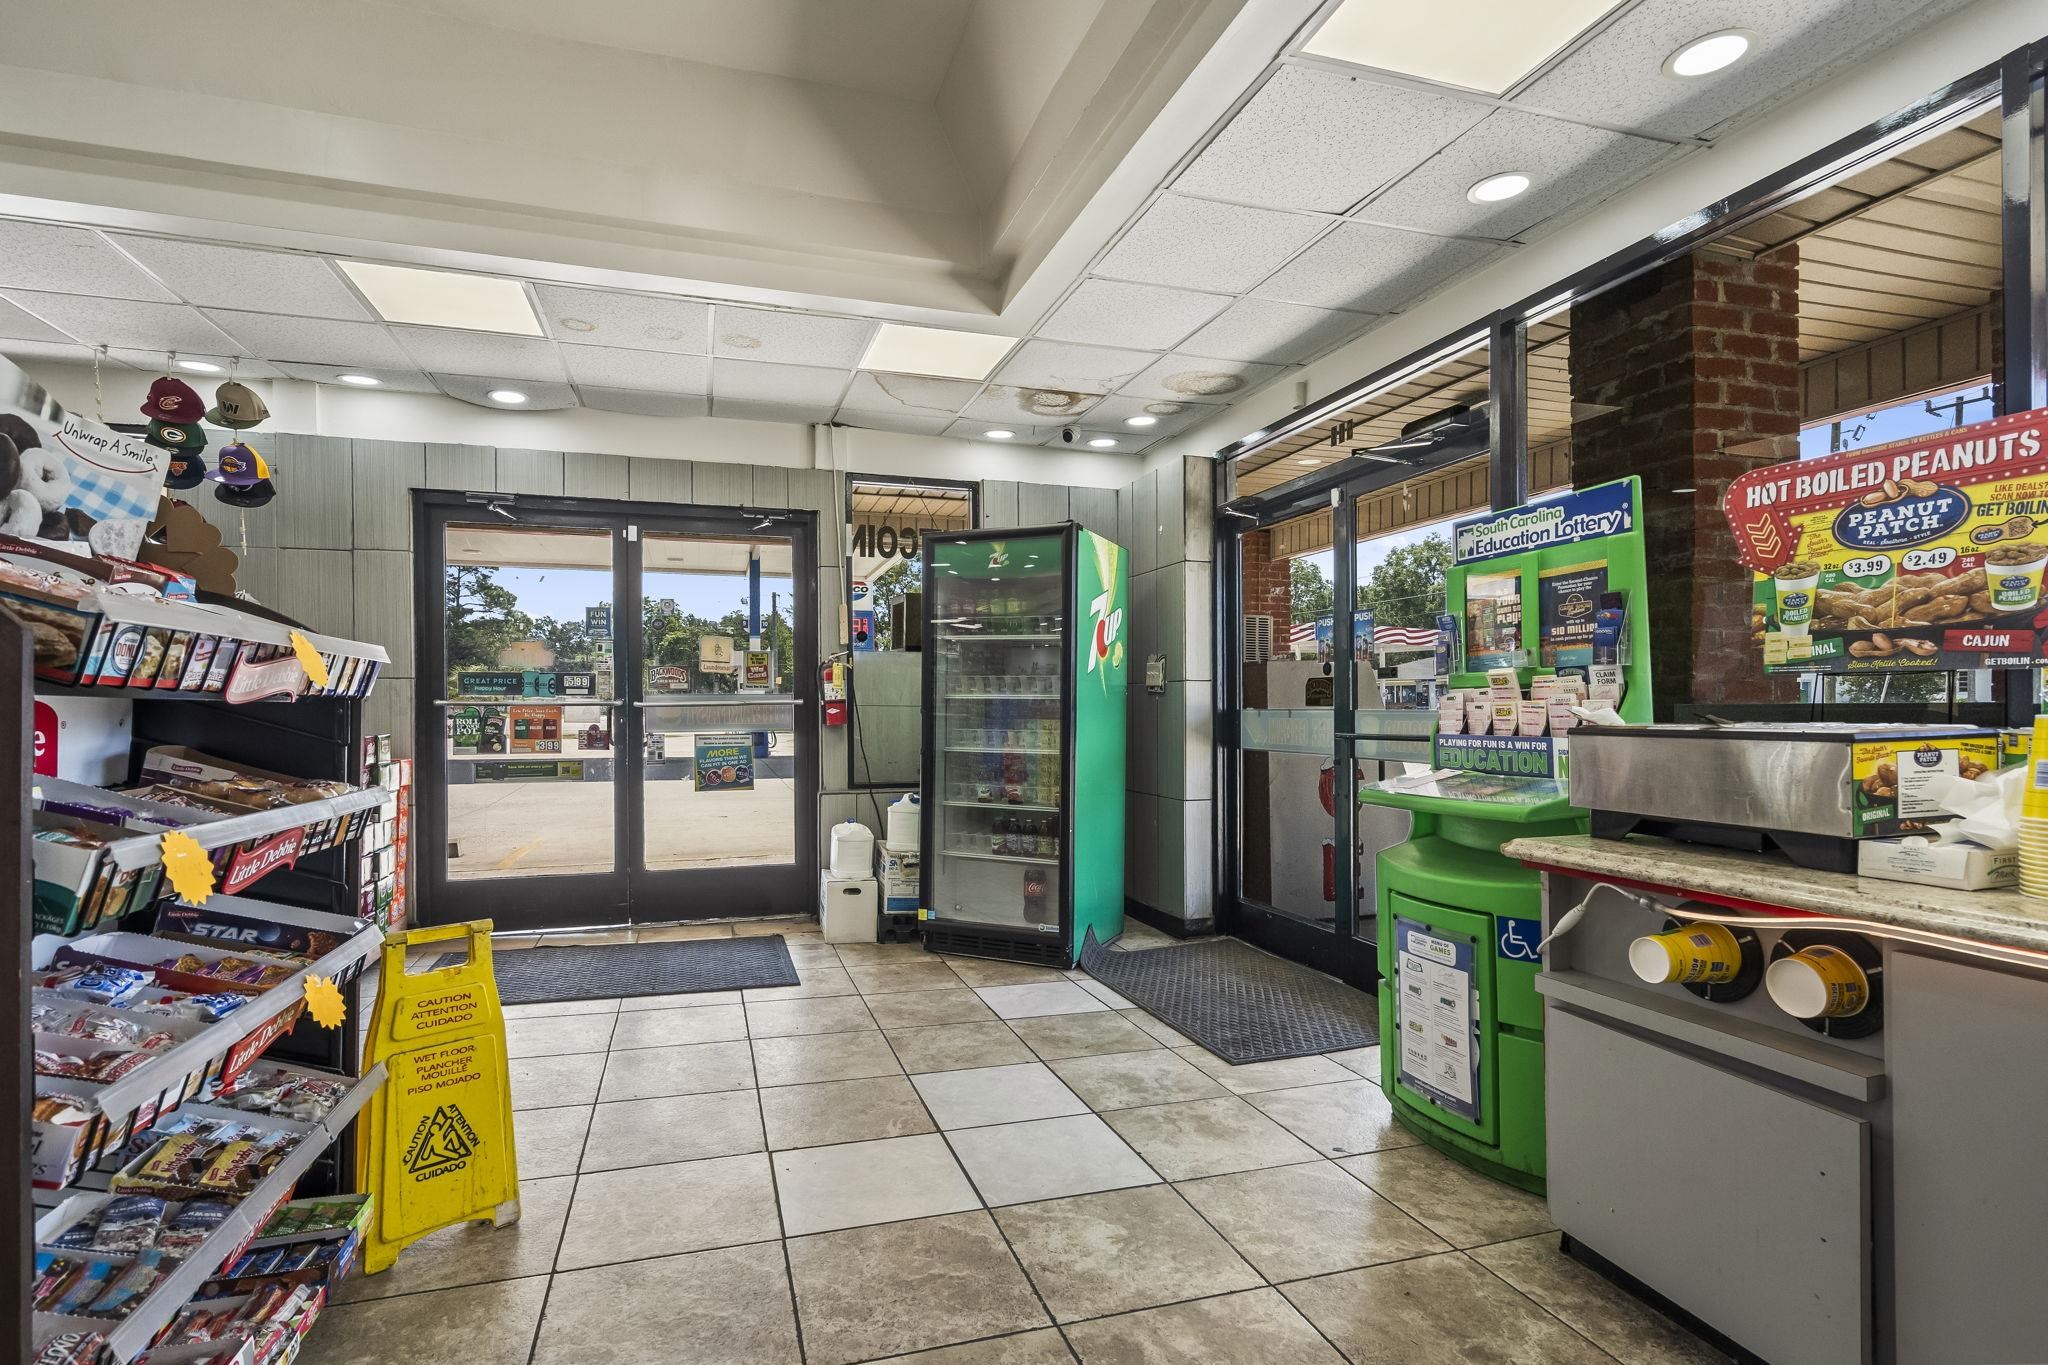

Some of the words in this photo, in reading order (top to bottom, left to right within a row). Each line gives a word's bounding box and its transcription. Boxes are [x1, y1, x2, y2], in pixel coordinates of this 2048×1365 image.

[63, 421, 108, 452] Unwrap
[109, 439, 120, 451] A
[122, 444, 153, 464] Smile
[1919, 432, 1943, 442] KETTLES
[1951, 427, 1968, 435] CANS
[1746, 479, 1791, 508] HOT
[1796, 462, 1885, 498] BOILED
[1893, 429, 2040, 481] PEANUTS
[1990, 492, 2014, 501] SCAN
[2016, 491, 2036, 500] NOW
[1995, 484, 2014, 492] LIKE
[1849, 498, 1952, 527] PEANUT
[1977, 502, 2003, 517] GET
[1475, 522, 1508, 537] South
[1510, 508, 1562, 528] Carolina
[1858, 515, 1940, 539] PATCH
[1476, 529, 1550, 555] Education
[1555, 511, 1620, 538] Lottery
[1914, 531, 1931, 540] STYLE
[988, 552, 1008, 568] 7UP
[1849, 560, 1883, 573] $3.99
[1908, 552, 1947, 566] $2.49
[1496, 594, 1521, 606] YOUR
[1354, 611, 1374, 622] PUSH
[1783, 614, 1808, 622] PEANUTS
[1786, 608, 1808, 616] BOILED
[1088, 590, 1123, 674] 7UP
[1962, 634, 2010, 647] CAJUN
[116, 644, 137, 657] DONU
[1812, 643, 1836, 656] INAL
[232, 671, 264, 694] Little
[264, 664, 298, 688] Debbie
[650, 667, 686, 682] BACKWOODS
[1596, 670, 1616, 678] CLAIM
[1597, 677, 1616, 685] FORM
[579, 731, 588, 749] PUSH
[1439, 739, 1467, 748] PLAYING
[1468, 740, 1481, 748] FOR
[1483, 740, 1498, 748] FUN
[1507, 741, 1513, 749] A
[1514, 741, 1530, 749] WIN
[1532, 742, 1547, 750] FOR
[707, 748, 739, 758] MORE
[1439, 748, 1548, 775] EDUCATION
[1862, 808, 1890, 821] ORIGINAL
[230, 858, 260, 885] Little
[262, 837, 297, 868] Debbie
[1993, 857, 2017, 865] FIRST
[192, 924, 258, 943] STAR
[1430, 945, 1450, 956] GAMES
[417, 992, 472, 1009] CAUTION
[410, 1002, 478, 1021] ATTENTION
[416, 1013, 472, 1030] CUIDADO
[228, 1043, 259, 1073] Little
[260, 1010, 295, 1041] Debbie
[413, 1053, 438, 1064] WET
[440, 1044, 474, 1061] FLOOR
[416, 1056, 472, 1074] PLANCHER
[421, 1063, 469, 1081] MOUILLÉ
[407, 1083, 433, 1096] PISO
[436, 1072, 480, 1092] MOJADO
[447, 1104, 480, 1148] ATTENTION
[403, 1115, 432, 1166] CAUTION
[161, 1155, 181, 1174] Nutty
[178, 1141, 199, 1161] Buddy
[218, 1164, 238, 1182] Nutty
[235, 1147, 256, 1169] Buddy
[415, 1160, 466, 1182] CUIDADO
